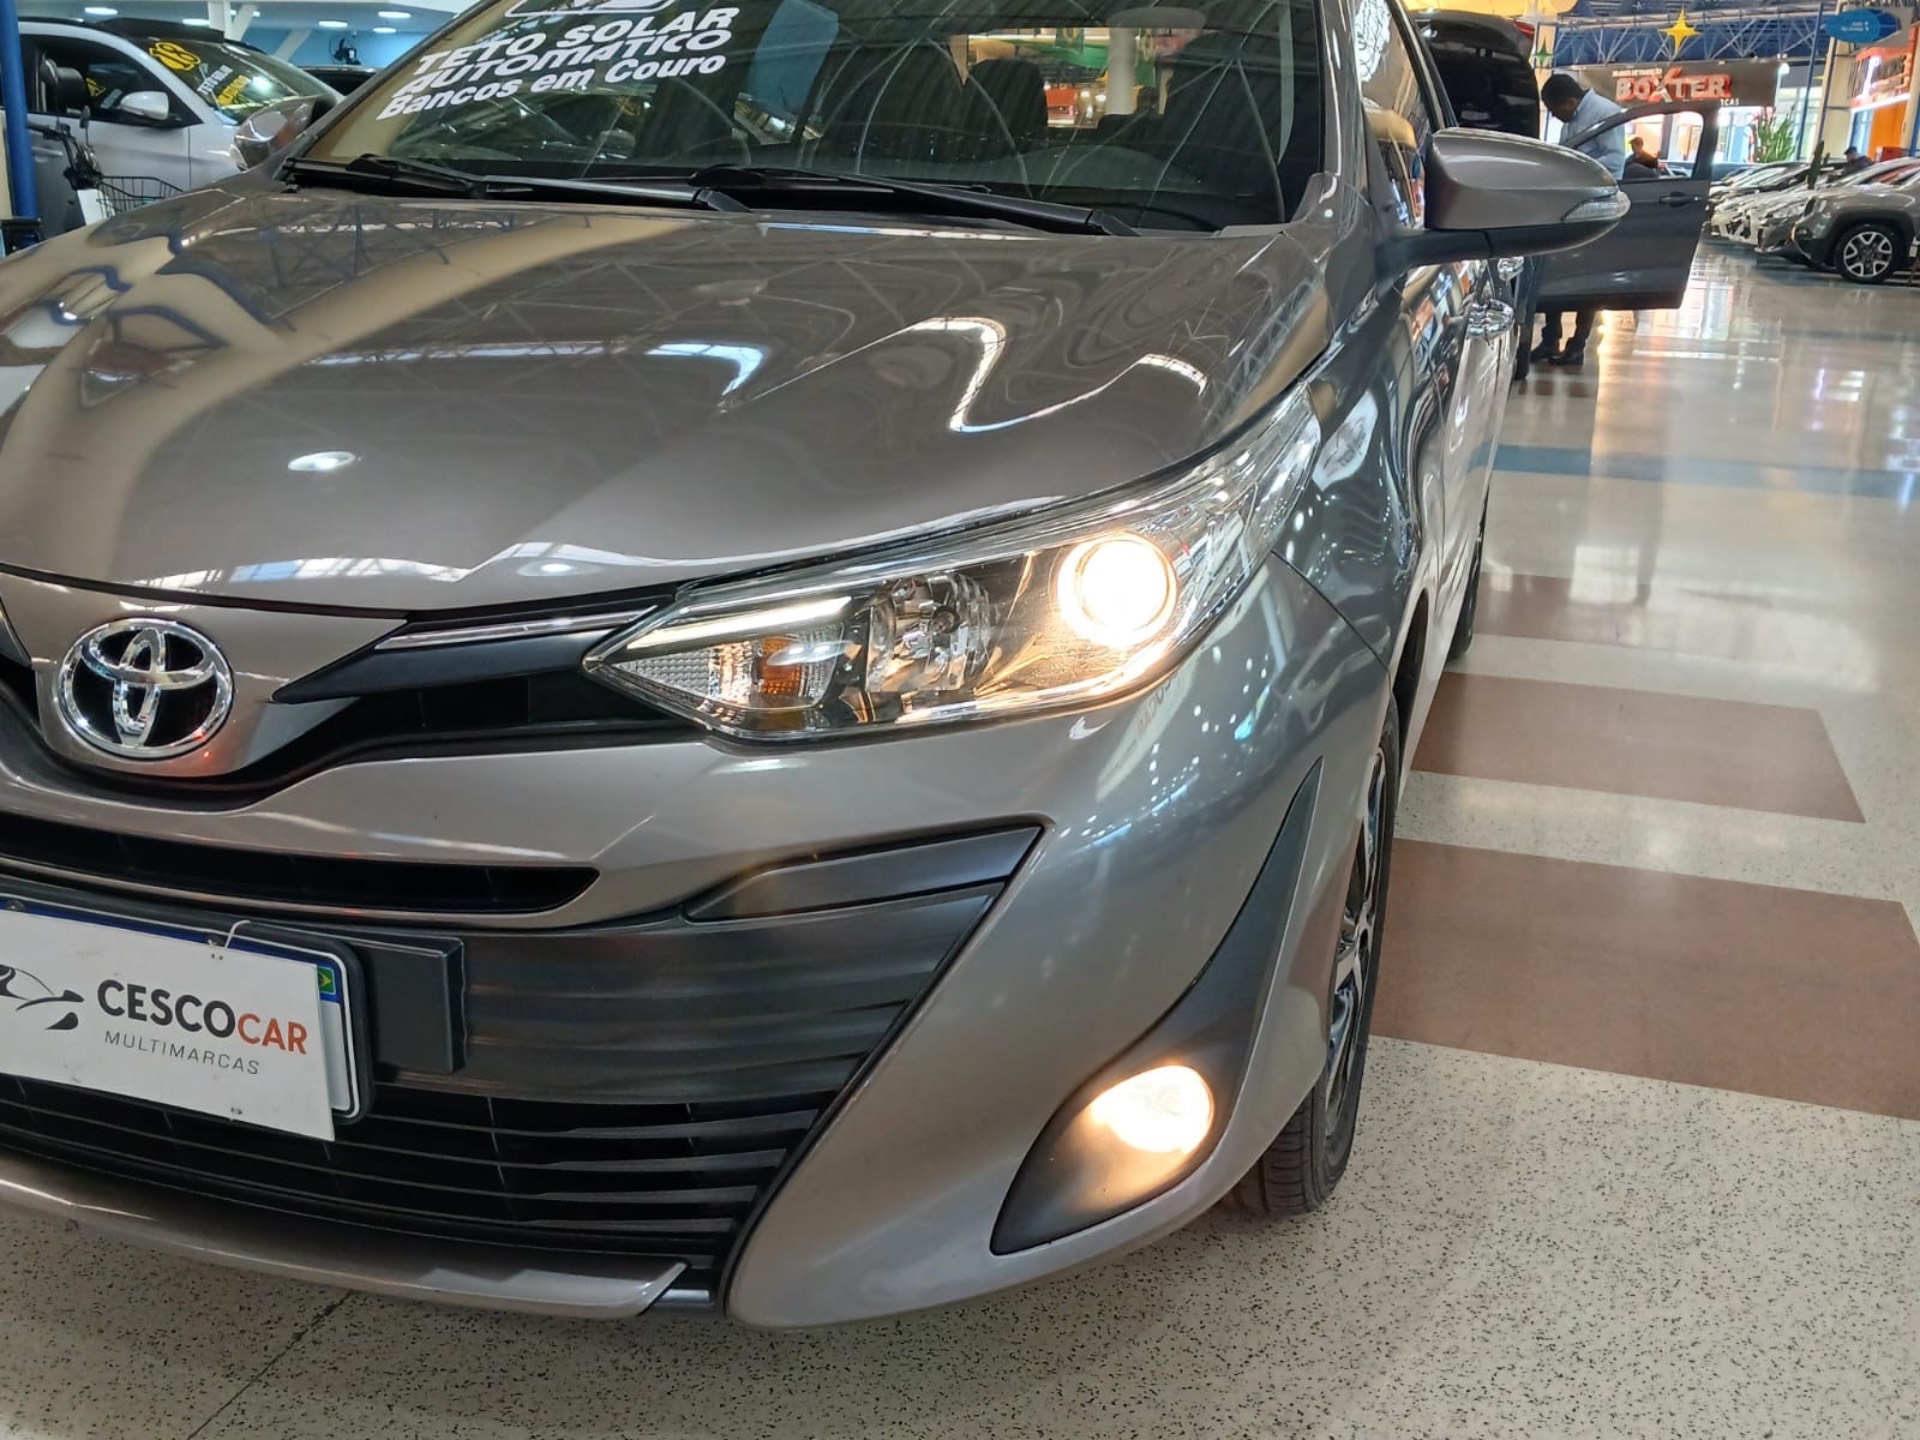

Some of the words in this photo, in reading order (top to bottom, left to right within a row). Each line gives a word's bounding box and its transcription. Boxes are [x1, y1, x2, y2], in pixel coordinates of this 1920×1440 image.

[391, 29, 732, 98] AUTOMATICO
[417, 32, 547, 75] TETO
[556, 7, 741, 49] SOLAR
[376, 78, 523, 121] Bancos
[531, 67, 595, 93] em
[604, 54, 727, 84] Couro
[1615, 66, 1732, 103] BOXTER
[97, 978, 308, 1055] CESCOCAR
[103, 1029, 261, 1076] MULTIMARCAS
